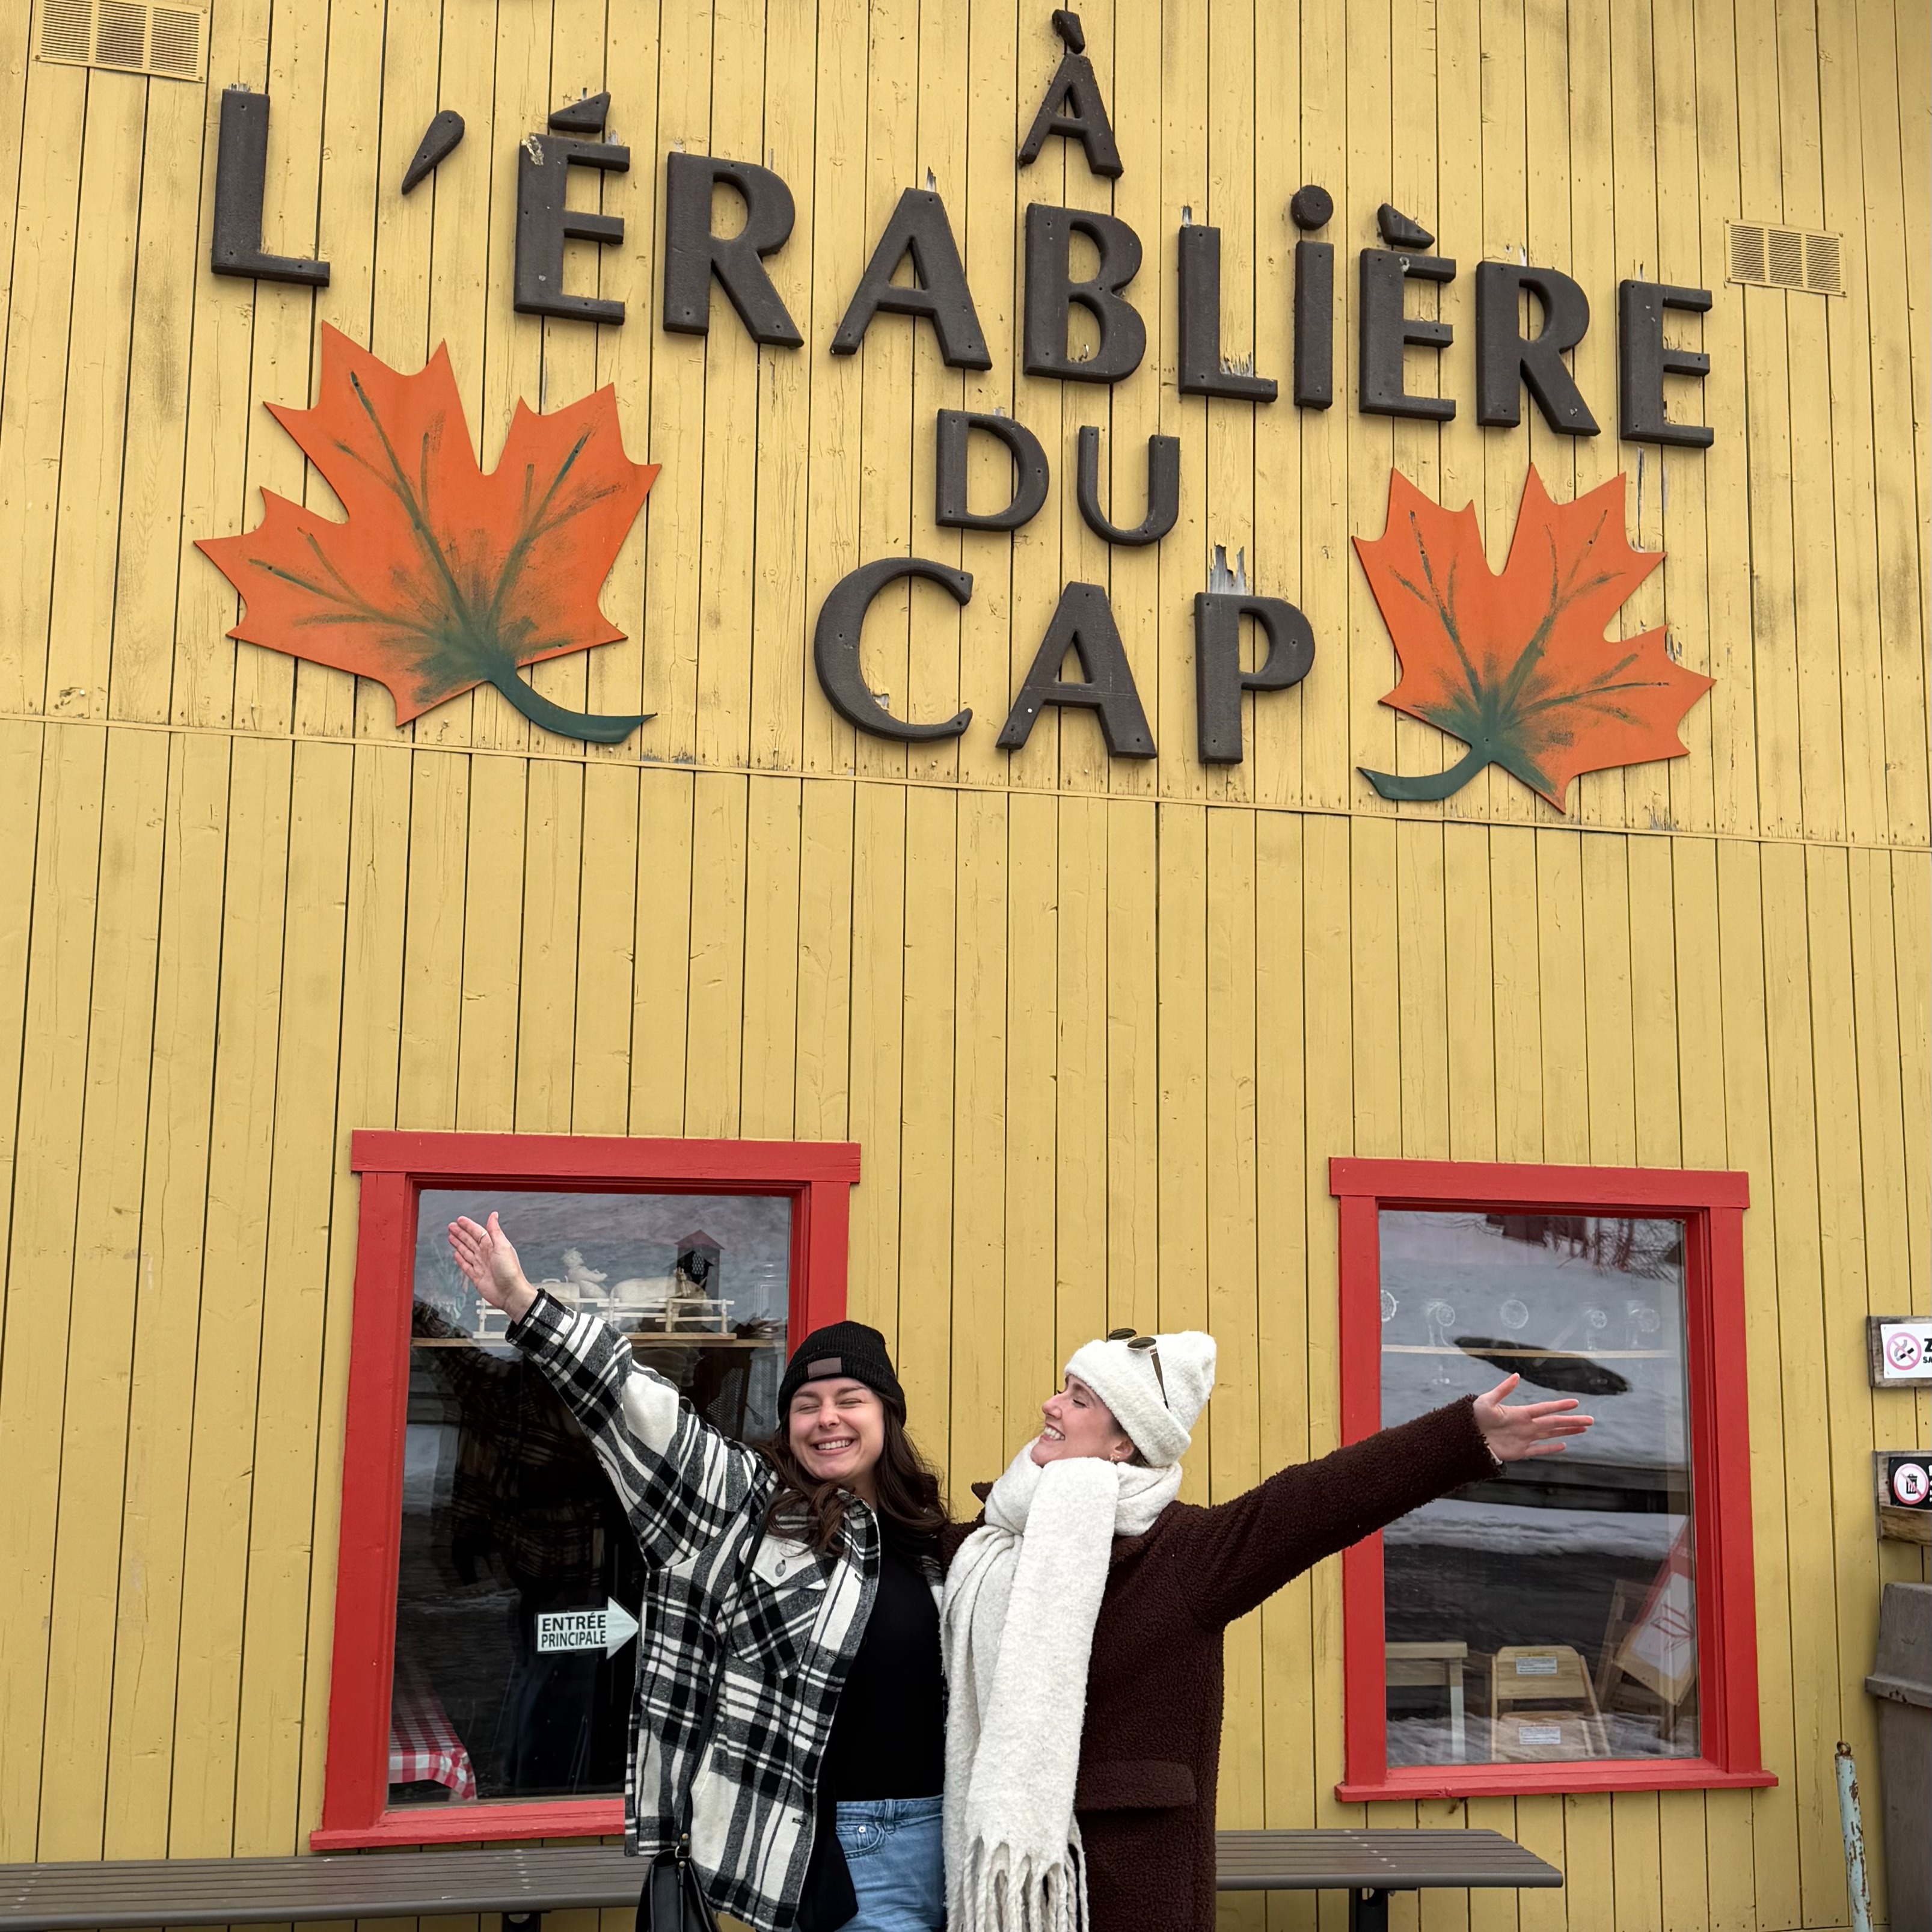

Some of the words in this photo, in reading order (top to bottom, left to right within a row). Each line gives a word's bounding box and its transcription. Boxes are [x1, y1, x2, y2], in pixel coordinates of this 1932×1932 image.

[1019, 9, 1124, 177] À
[936, 408, 1180, 547] DU
[814, 557, 1316, 764] CAP
[541, 1630, 606, 1648] PRINCIPALE
[542, 1612, 606, 1632] ENTRÉE
